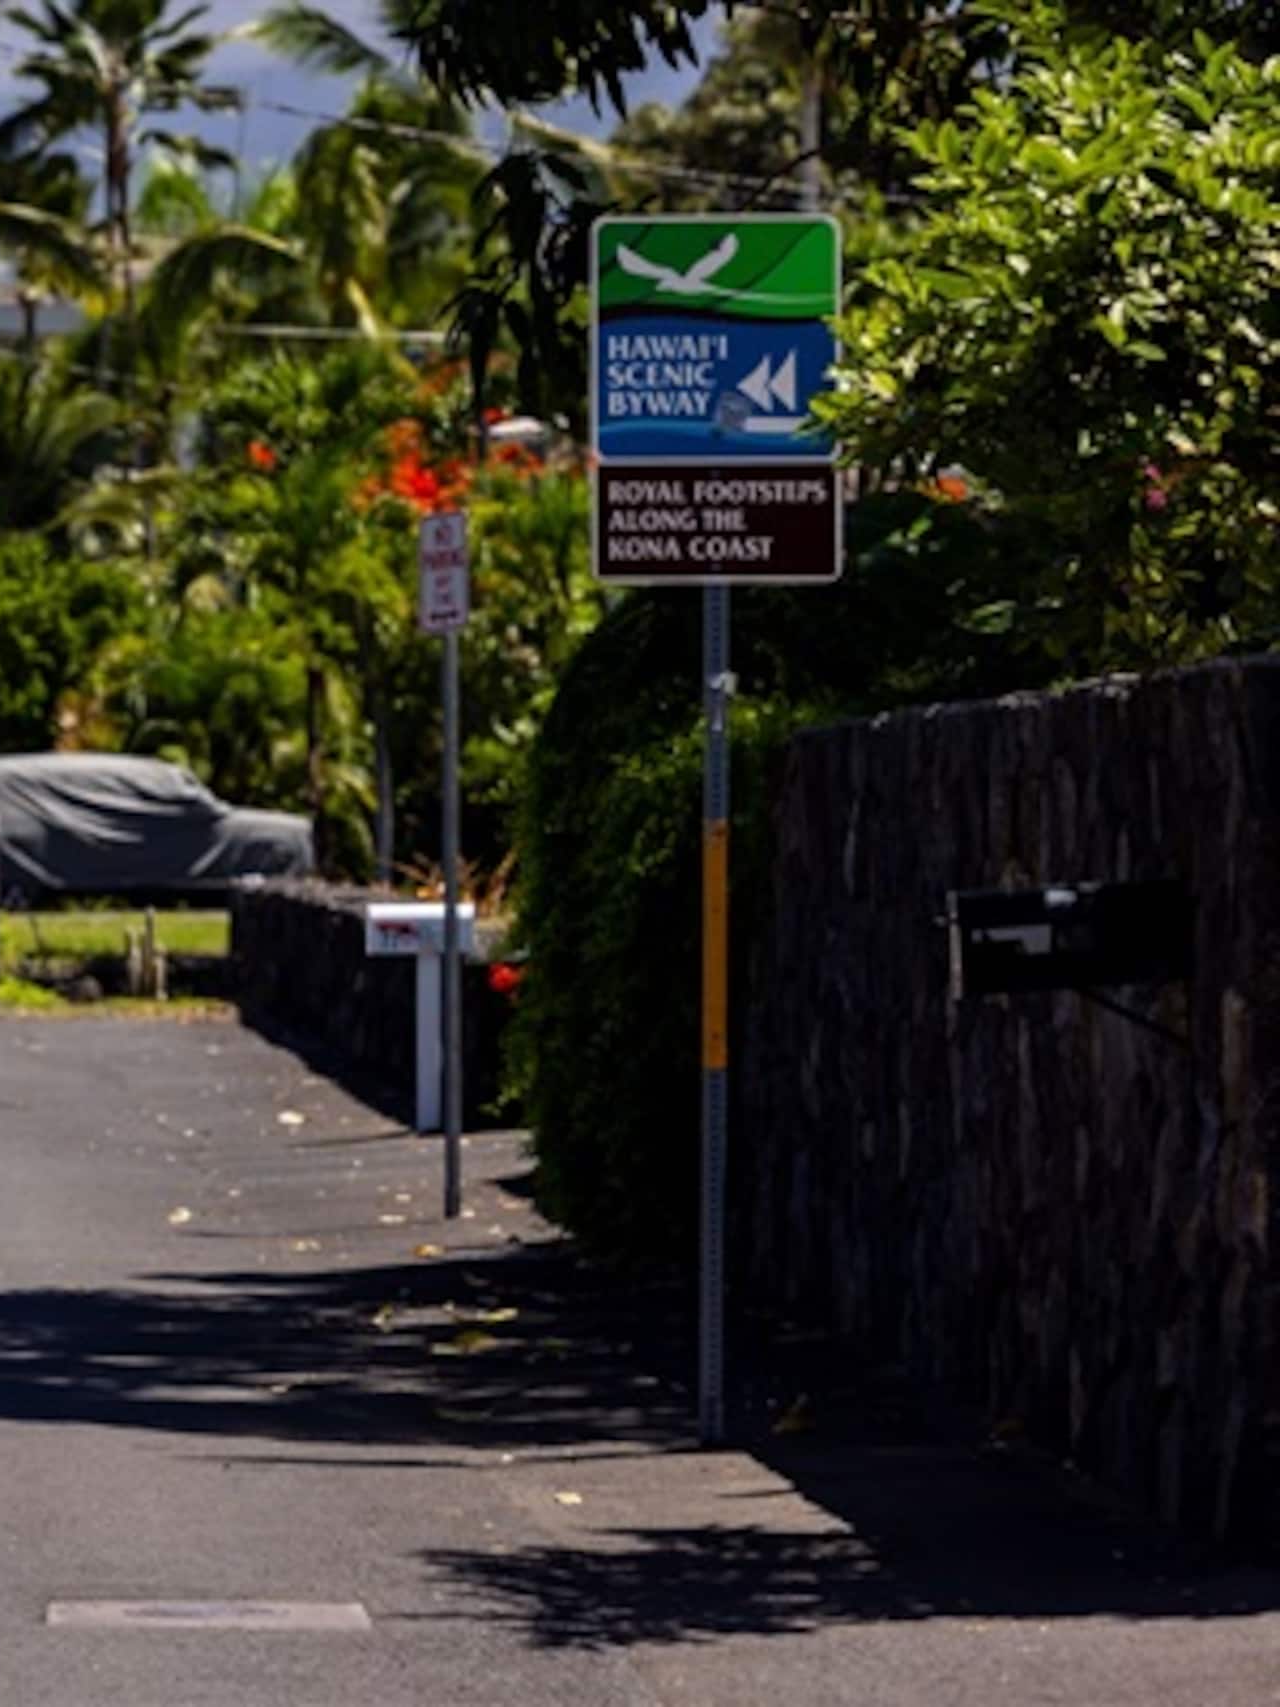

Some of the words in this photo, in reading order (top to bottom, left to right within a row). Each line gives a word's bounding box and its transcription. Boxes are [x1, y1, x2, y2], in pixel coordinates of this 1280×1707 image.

[608, 363, 715, 387] SCENIC
[609, 391, 710, 415] BYWAY
[608, 481, 685, 503] ROYAL
[693, 481, 827, 503] FOOTSTEPS
[608, 509, 697, 531] ALONG
[702, 509, 746, 531] THE
[608, 537, 681, 560] KONA
[688, 537, 773, 560] COAST
